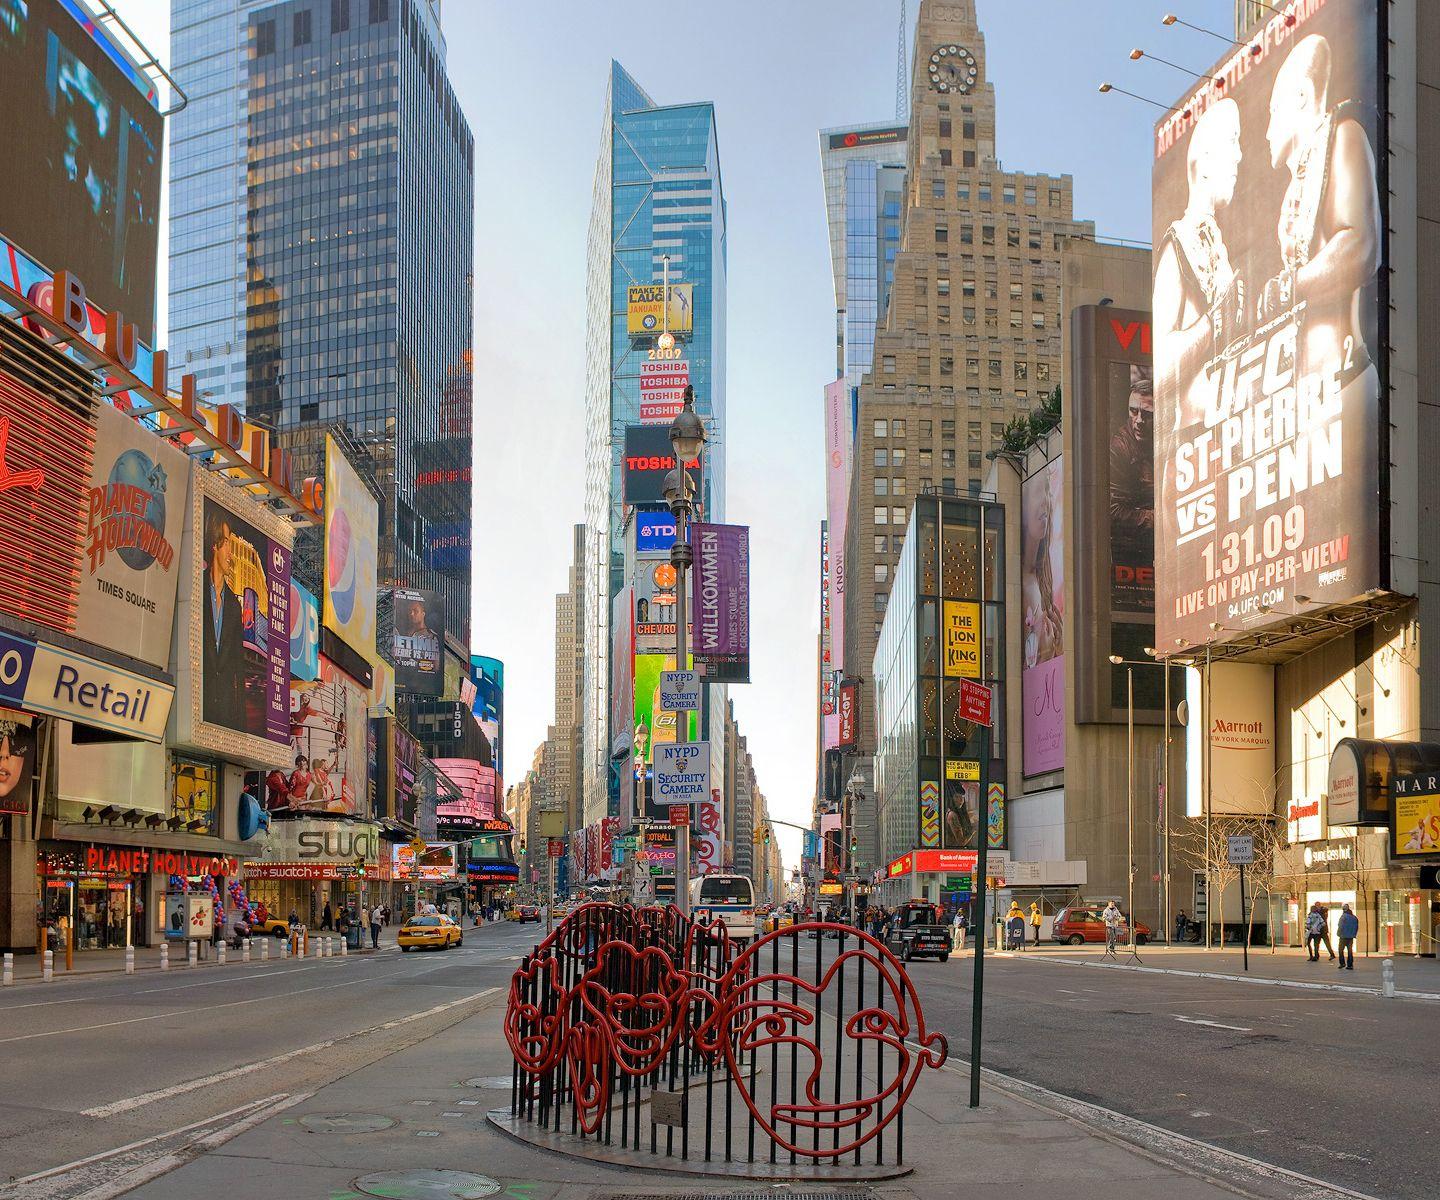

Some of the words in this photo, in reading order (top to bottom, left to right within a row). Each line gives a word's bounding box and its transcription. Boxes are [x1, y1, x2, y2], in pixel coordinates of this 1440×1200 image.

[629, 287, 654, 296] MAKE
[629, 304, 662, 314] JANUARY
[648, 349, 683, 360] 2009
[642, 363, 688, 372] TOSHIBA
[642, 377, 688, 386] TOSHIBA
[1201, 324, 1298, 429] UFC
[1343, 335, 1355, 372] 2
[52, 270, 326, 514] BUILDING
[1175, 370, 1343, 493] ST-PIERRE
[1176, 495, 1216, 536] VS
[1228, 420, 1343, 523] PENN
[87, 483, 152, 536] PLANET
[87, 516, 174, 575] HOLLYWOOD
[1201, 505, 1305, 582] 1.31.09
[1175, 591, 1206, 619] LIVE
[1207, 584, 1229, 608] ON
[1231, 534, 1350, 600] PAY-PER-VIEW
[97, 578, 124, 599] TIMES
[126, 590, 156, 613] SQUARE
[272, 581, 286, 597] BOOK
[702, 531, 718, 649] WILLKOMMEN
[275, 594, 288, 611] NIGHT
[272, 608, 285, 622] WITH
[952, 615, 972, 627] THE
[949, 629, 976, 647] LION
[949, 649, 977, 667] KING
[666, 673, 693, 682] NYPD
[53, 664, 151, 723] Retail
[661, 692, 698, 702] SECURITY
[969, 685, 990, 700] STOPPING
[663, 700, 697, 709] CAMERA
[965, 694, 986, 709] ANYTIME
[454, 702, 462, 738] 1500
[1212, 719, 1263, 734] Marriott
[1241, 737, 1270, 745] MARQUIS
[664, 747, 699, 760] NYPD
[956, 760, 980, 770] SUNDAY
[658, 773, 706, 784] SECURITY
[660, 783, 704, 795] CAMERA
[1339, 844, 1351, 859] hut
[87, 847, 149, 875] PLANET
[152, 852, 240, 878] HOLLYWOOD
[269, 865, 311, 879] swatch
